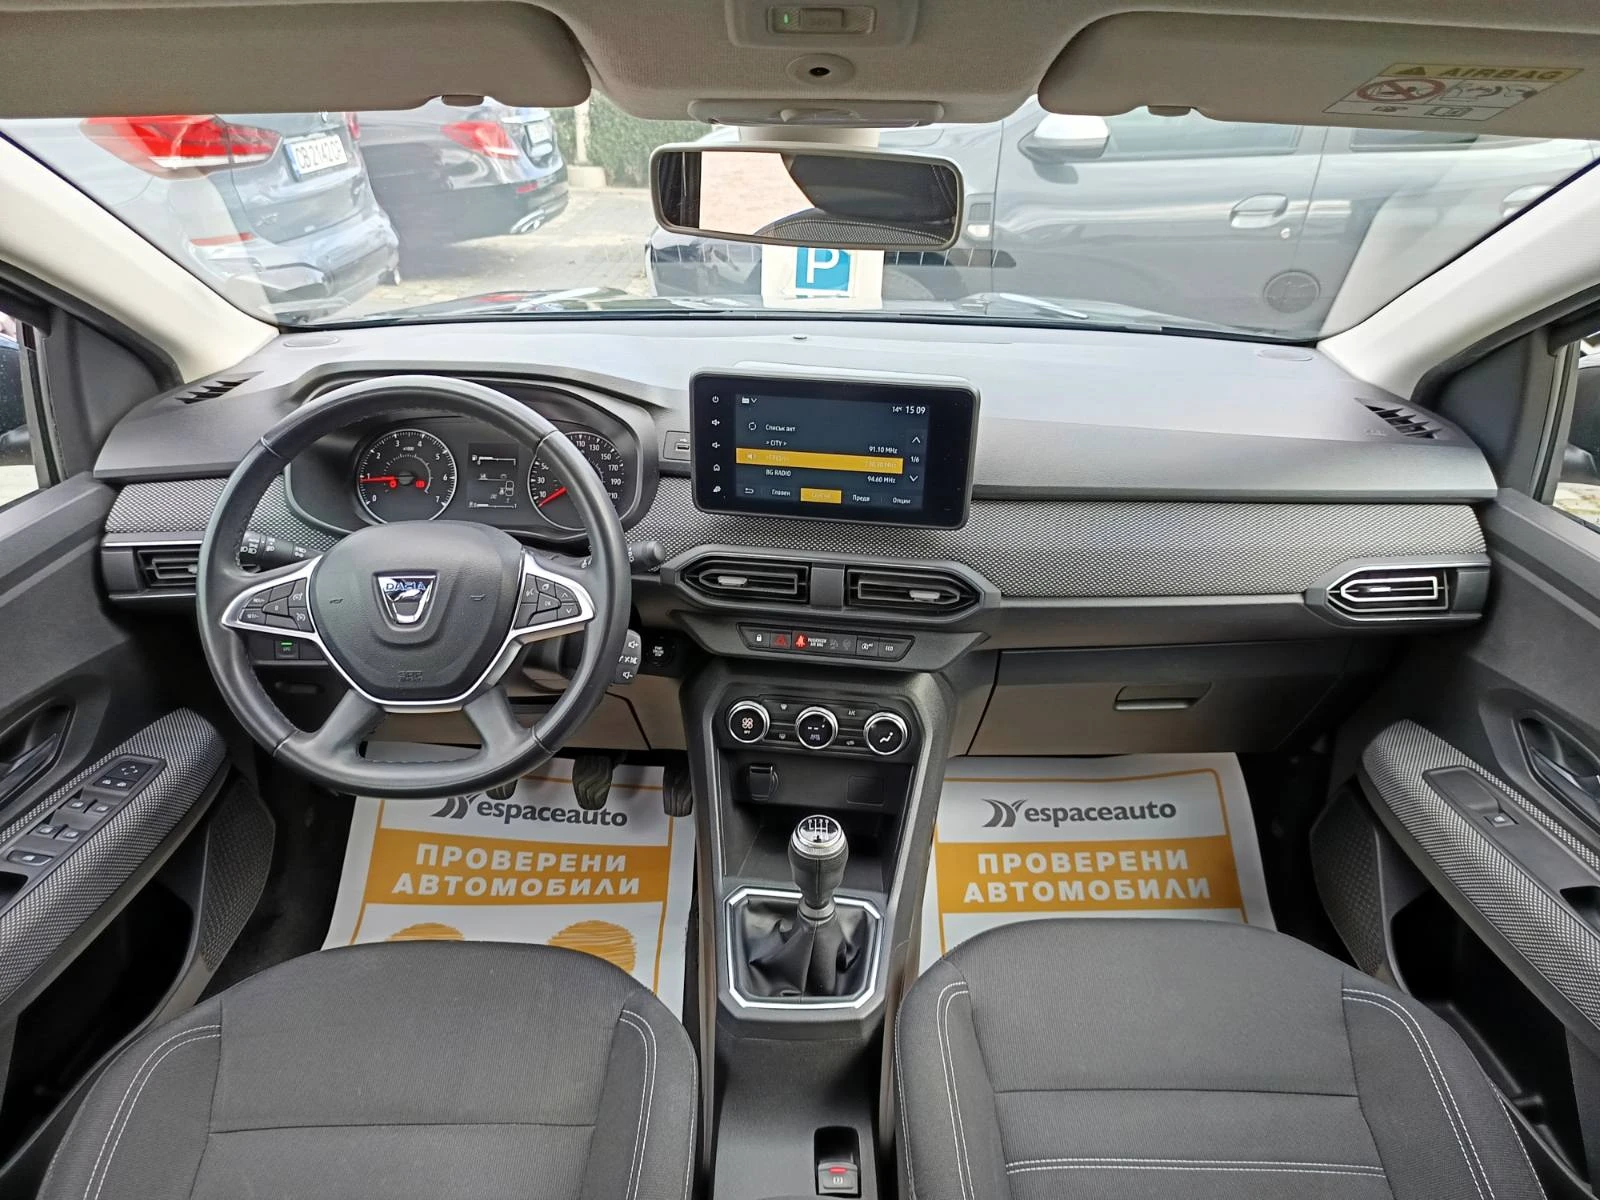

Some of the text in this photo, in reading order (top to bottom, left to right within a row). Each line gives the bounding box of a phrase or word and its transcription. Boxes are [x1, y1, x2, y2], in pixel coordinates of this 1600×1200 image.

[1438, 67, 1564, 80] AIRBAG
[806, 248, 840, 284] P
[610, 478, 622, 486] 190
[384, 581, 427, 592] DACIA
[476, 800, 628, 827] espaceauto
[1024, 800, 1177, 828] espaceauto
[416, 843, 627, 873] ПРОВЕРЕНИ
[977, 849, 1189, 875] ПРОВЕРЕНИ
[391, 873, 641, 897] АВТОМОБИЛИ
[963, 877, 1212, 904] АВТОМОБИЛИ
